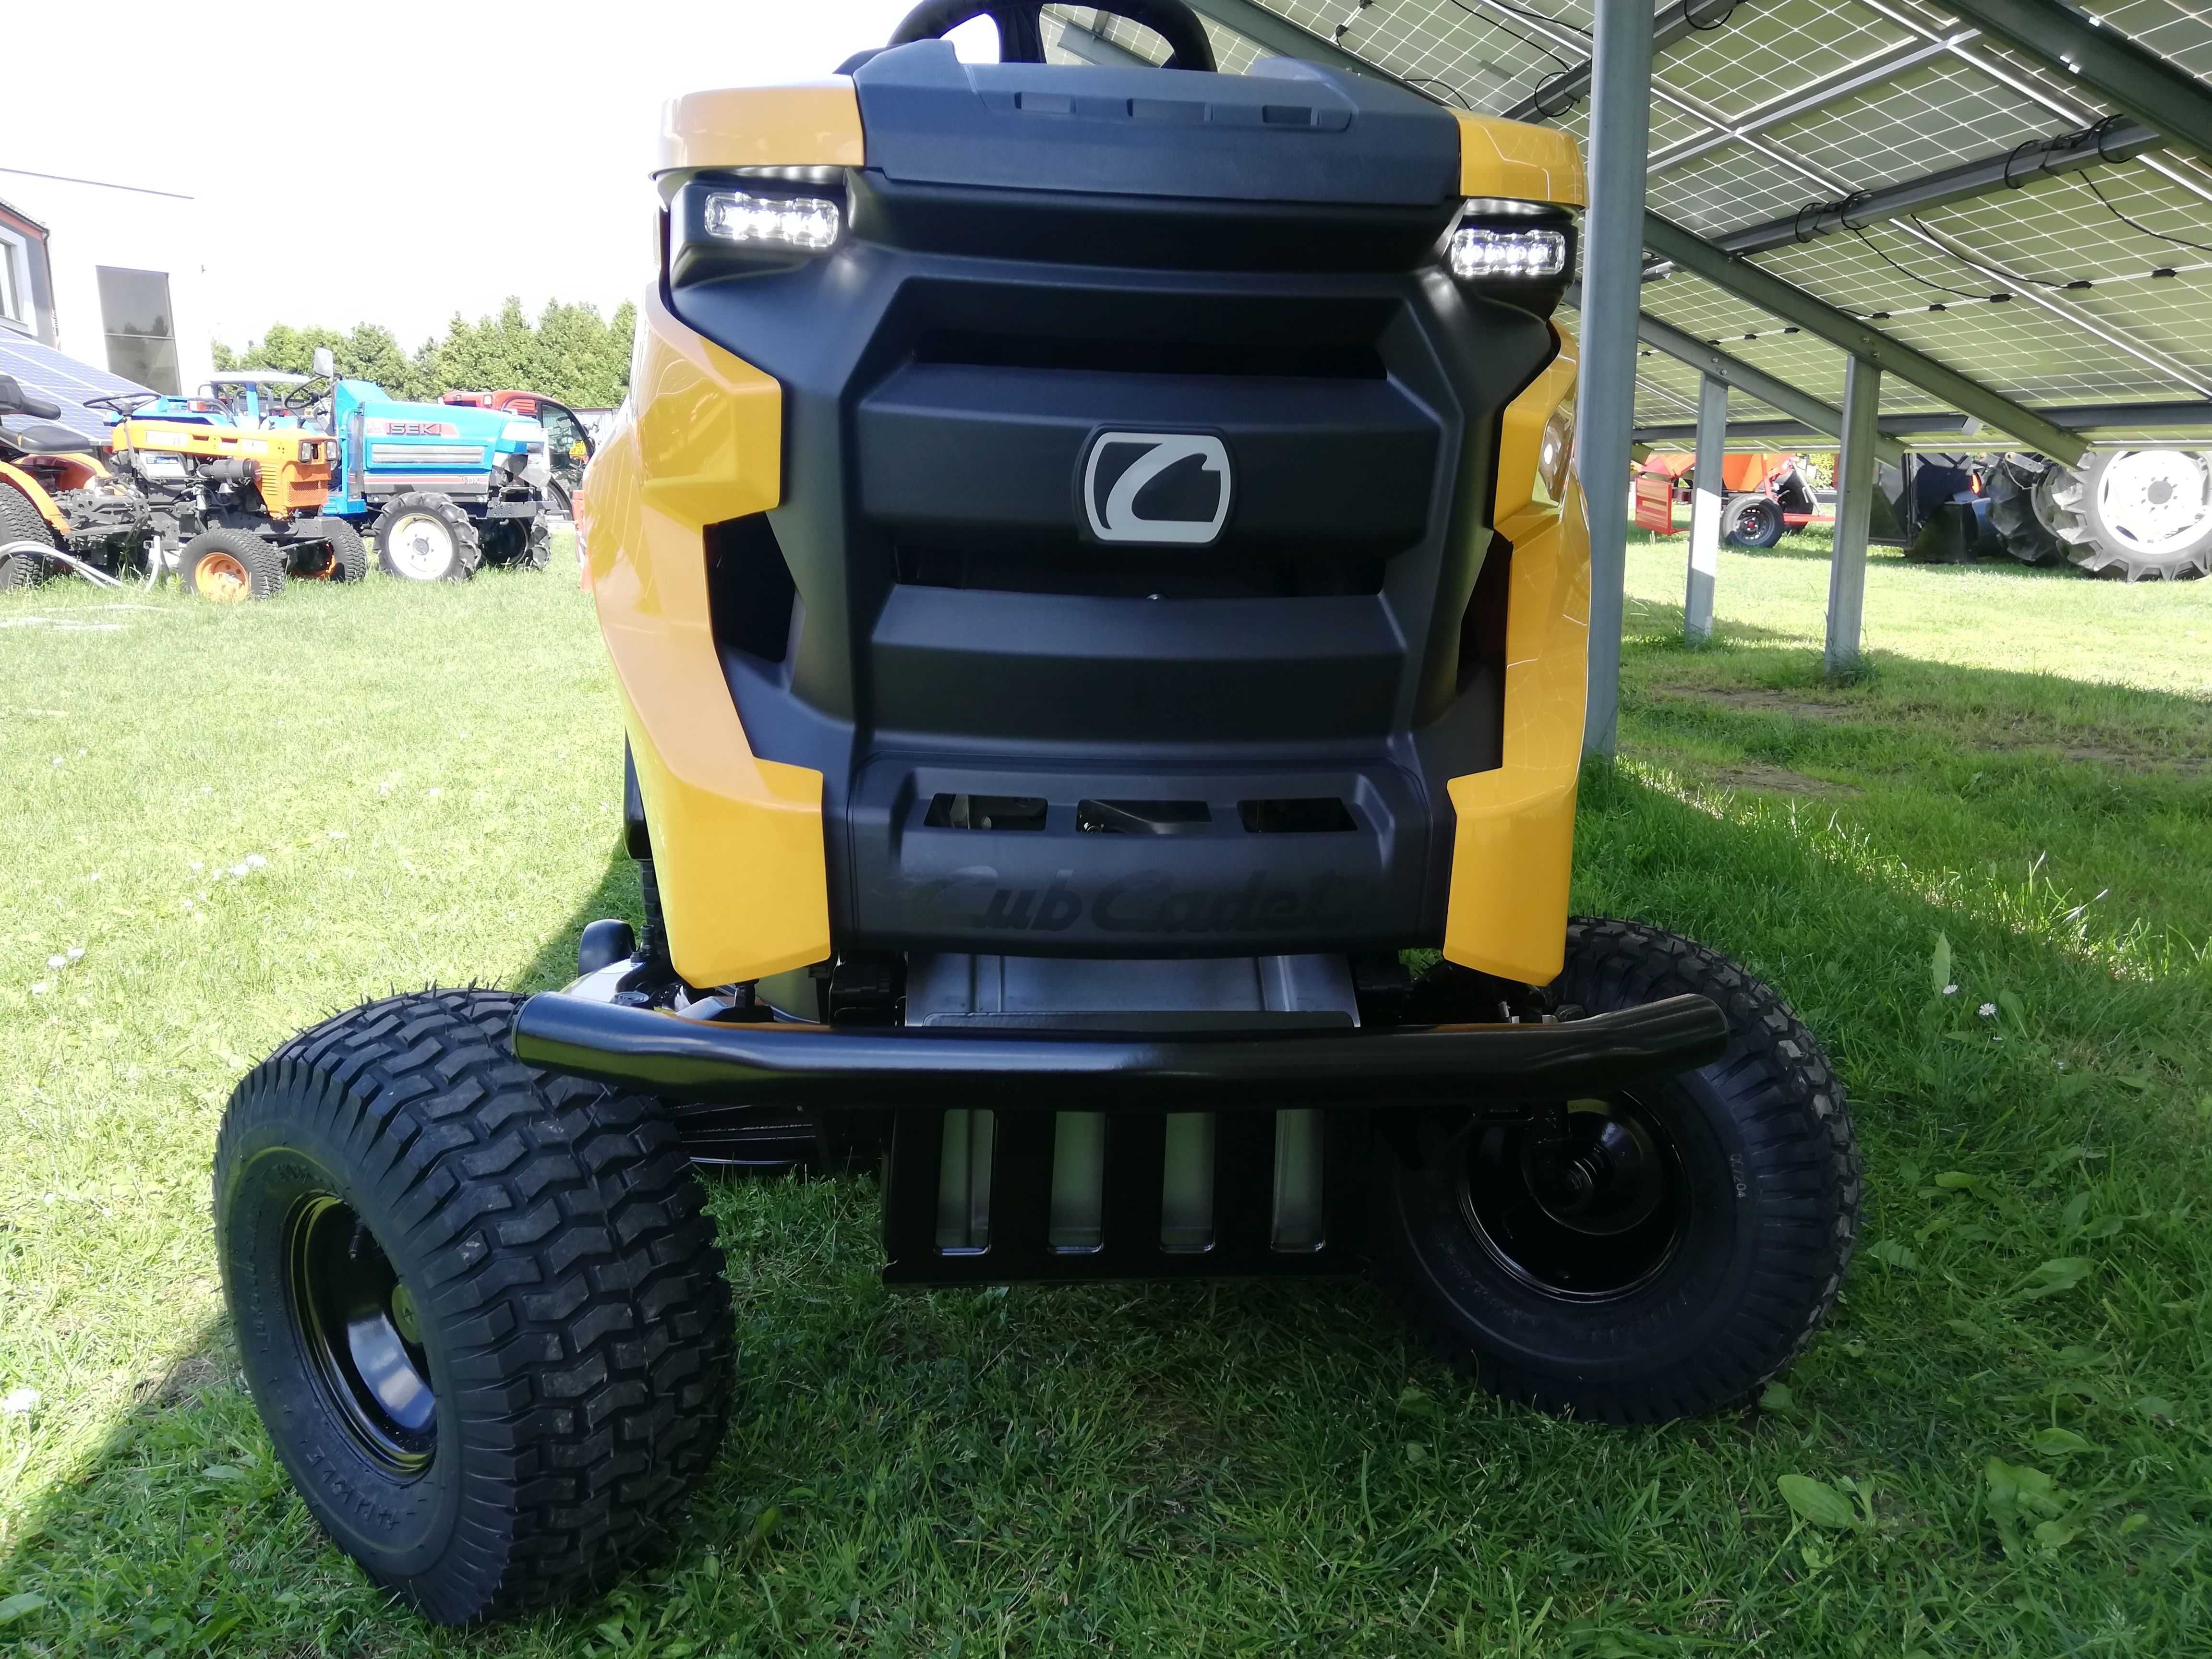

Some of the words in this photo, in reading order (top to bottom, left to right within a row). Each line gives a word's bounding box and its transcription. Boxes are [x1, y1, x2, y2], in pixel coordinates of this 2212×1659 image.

[387, 423, 441, 435] ISEKI
[916, 863, 1082, 932] Cub
[1091, 867, 1353, 933] Cadet
